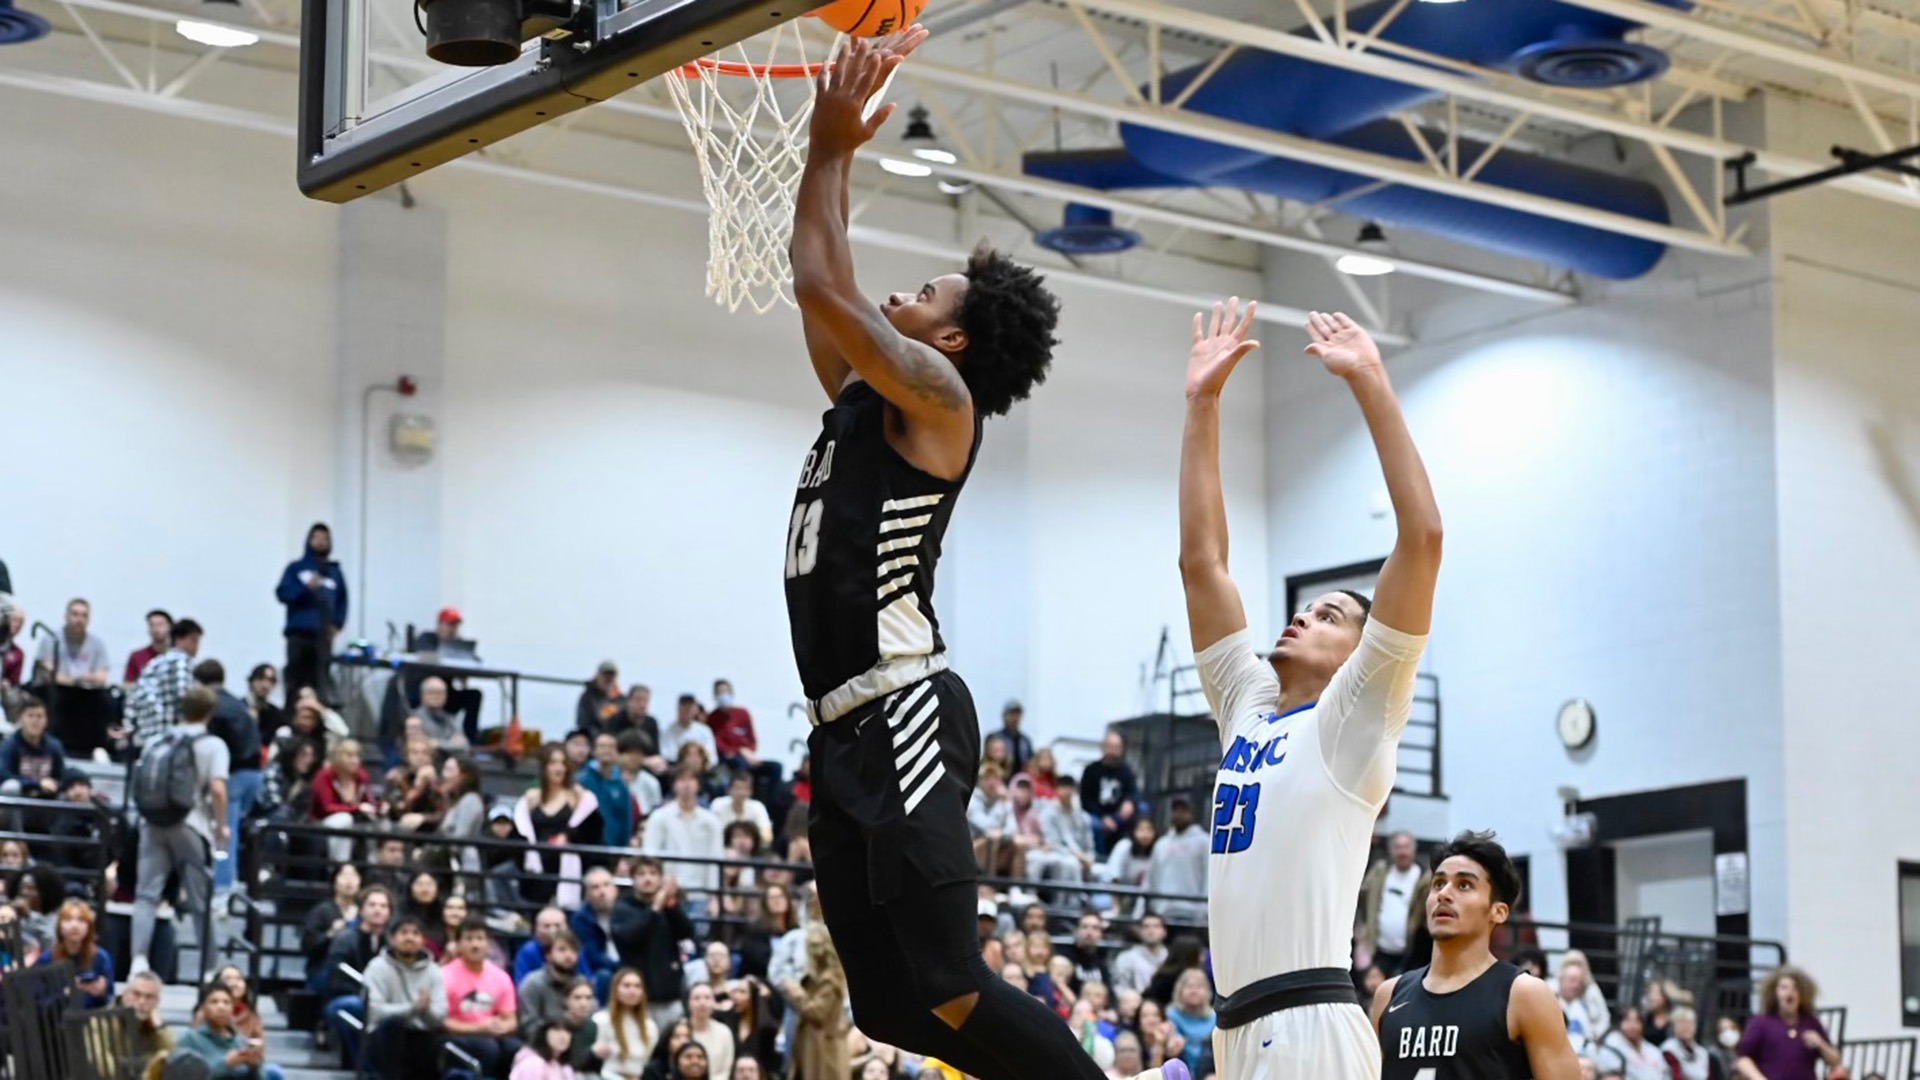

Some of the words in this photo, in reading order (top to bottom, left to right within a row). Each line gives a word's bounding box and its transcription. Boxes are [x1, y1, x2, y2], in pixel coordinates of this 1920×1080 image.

[798, 439, 836, 489] BAD
[1211, 782, 1261, 854] 23
[1399, 1025, 1459, 1059] BARD
